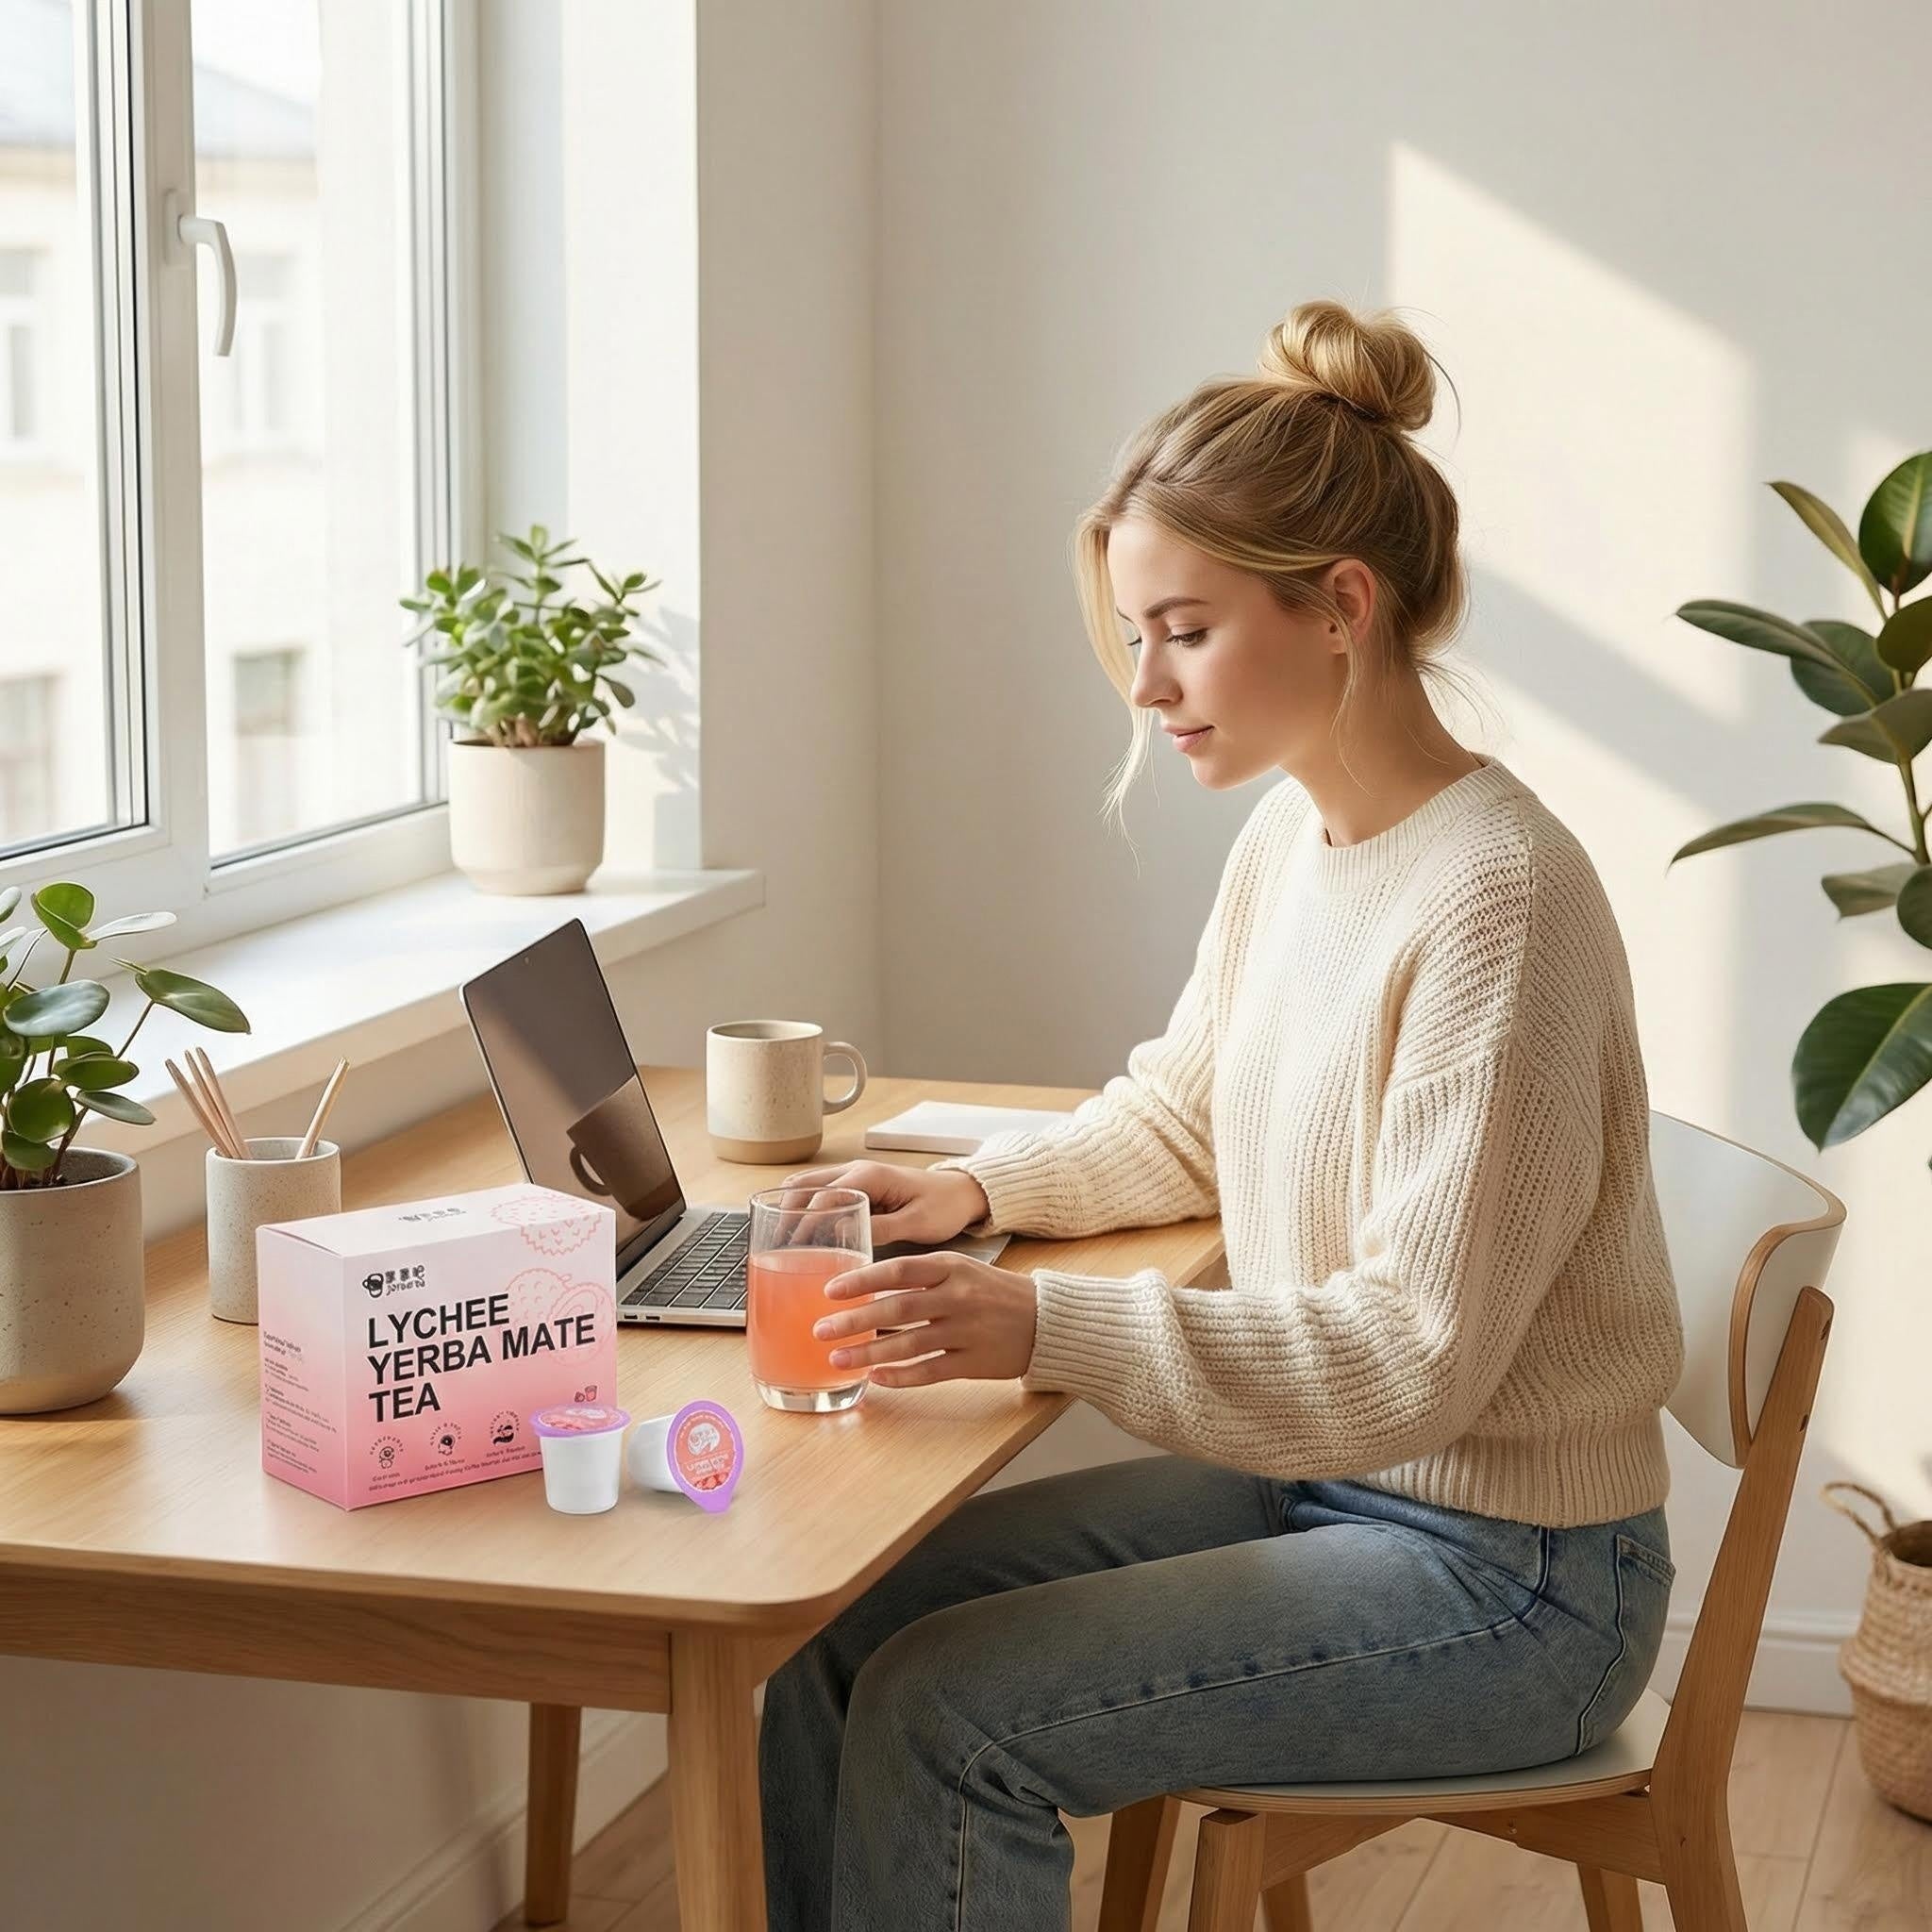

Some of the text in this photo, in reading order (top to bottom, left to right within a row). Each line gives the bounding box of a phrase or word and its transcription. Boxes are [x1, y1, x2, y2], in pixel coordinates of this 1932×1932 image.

[368, 1293, 509, 1348] LYCHEE
[367, 1335, 492, 1385] YERBA
[502, 1313, 596, 1360] MATE
[368, 1382, 441, 1423] TEA
